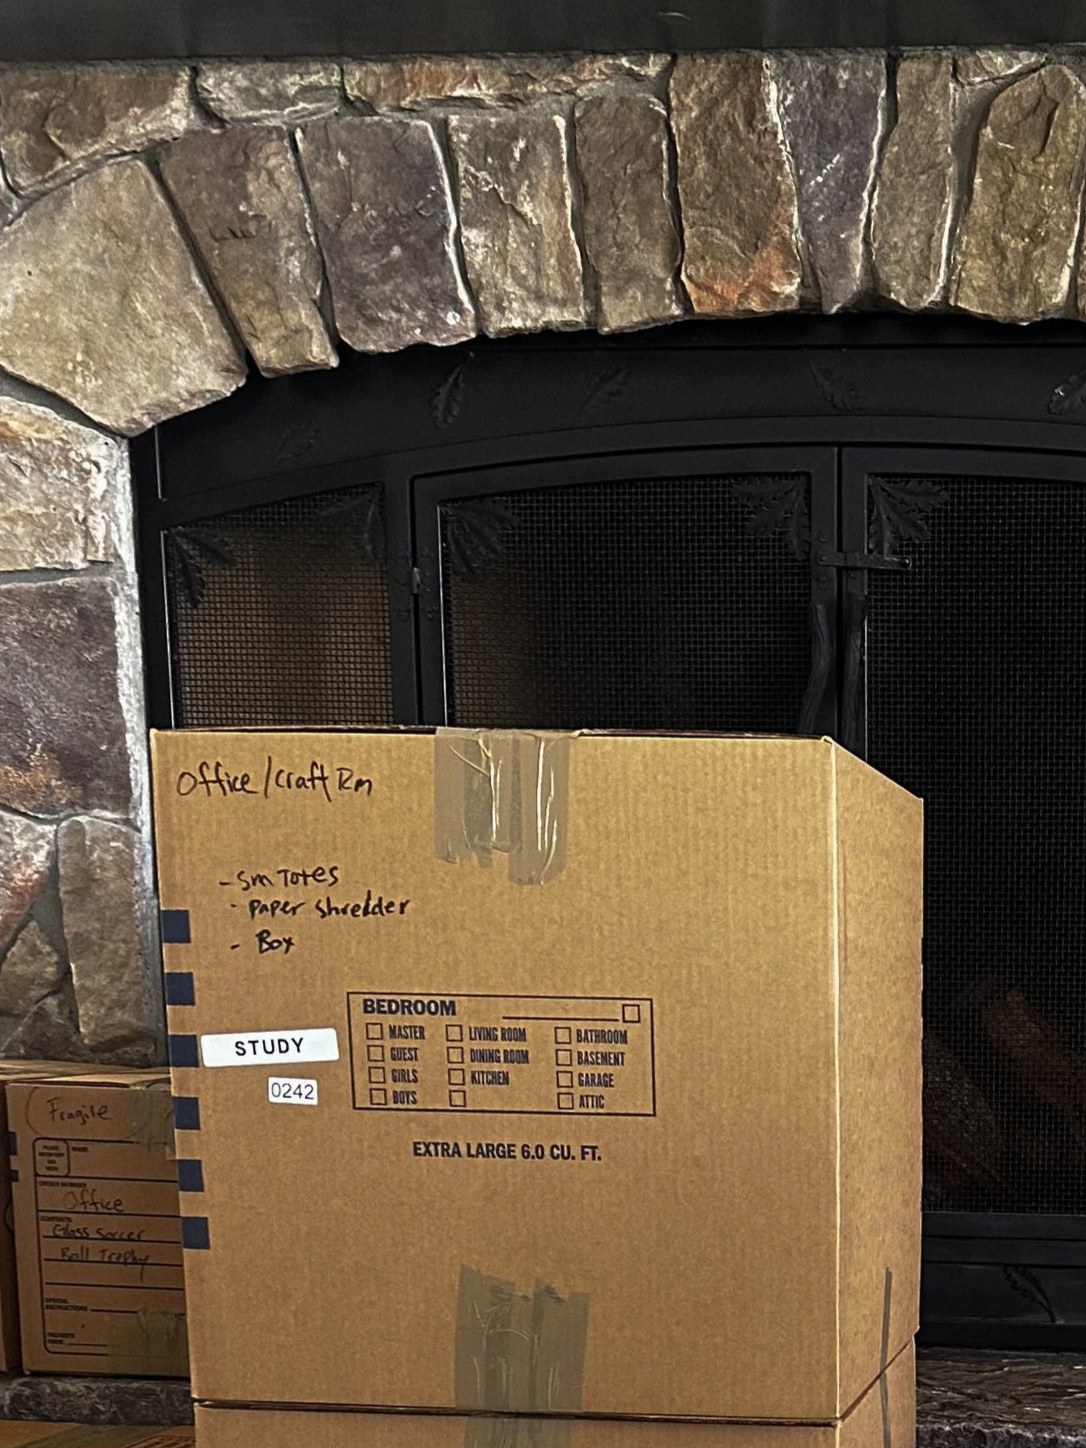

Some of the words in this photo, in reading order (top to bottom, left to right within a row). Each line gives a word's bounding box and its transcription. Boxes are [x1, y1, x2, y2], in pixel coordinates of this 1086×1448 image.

[255, 929, 295, 954] Box
[362, 998, 457, 1017] BEDROOM
[389, 1025, 425, 1040] MASTER
[469, 1026, 498, 1041] LIVING
[501, 1027, 526, 1042] ROOM
[576, 1029, 628, 1044] BATHROOM
[234, 1037, 304, 1057] STUDY
[390, 1047, 418, 1061] GUEST
[470, 1048, 500, 1063] DINING
[503, 1049, 529, 1064] ROOM
[577, 1051, 625, 1066] BASEMENT
[391, 1069, 418, 1083] GIRLS
[471, 1070, 509, 1085] KITCHEN
[578, 1073, 614, 1088] GARAGE
[271, 1082, 314, 1100] 0242
[392, 1090, 417, 1105] BOYS
[579, 1094, 604, 1109] ATTIC
[47, 1097, 113, 1126] Fragile
[413, 1141, 462, 1158] EXTRA
[466, 1142, 517, 1159] LARGE
[521, 1144, 545, 1160] 6.0
[550, 1144, 576, 1160] CU.
[581, 1145, 602, 1161] FT.
[63, 1188, 125, 1212] Office
